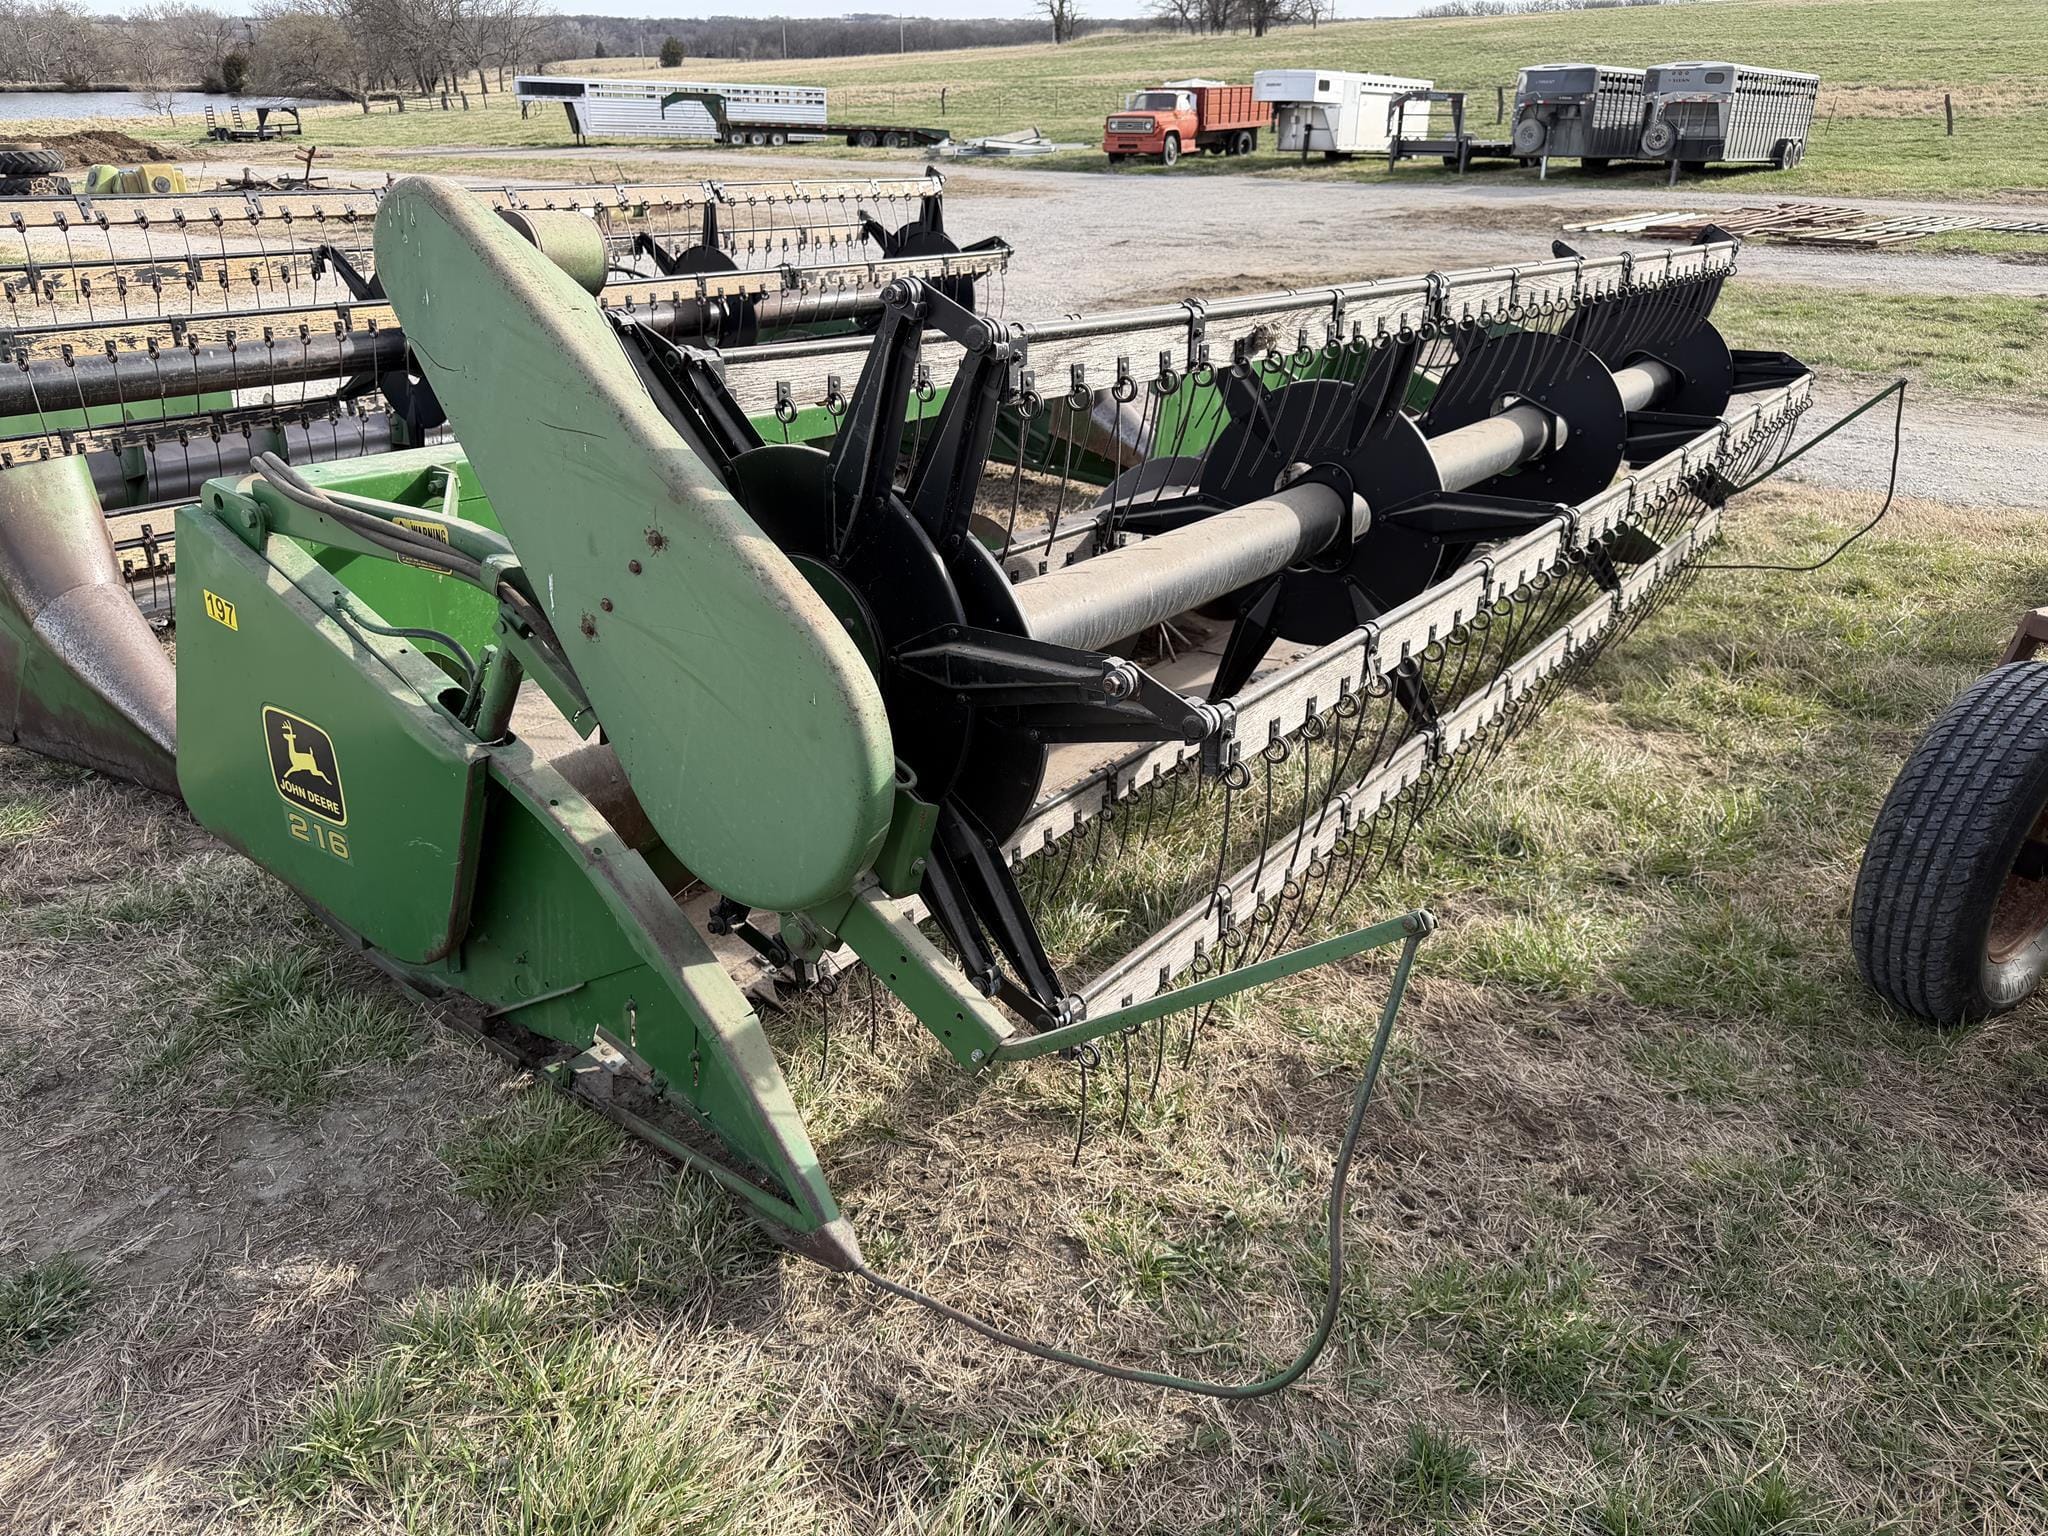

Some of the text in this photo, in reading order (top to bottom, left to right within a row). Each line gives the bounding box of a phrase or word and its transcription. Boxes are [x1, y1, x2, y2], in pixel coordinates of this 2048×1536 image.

[207, 593, 234, 625] 197
[280, 778, 341, 815] JOHN DEERE
[288, 812, 350, 860] 216
